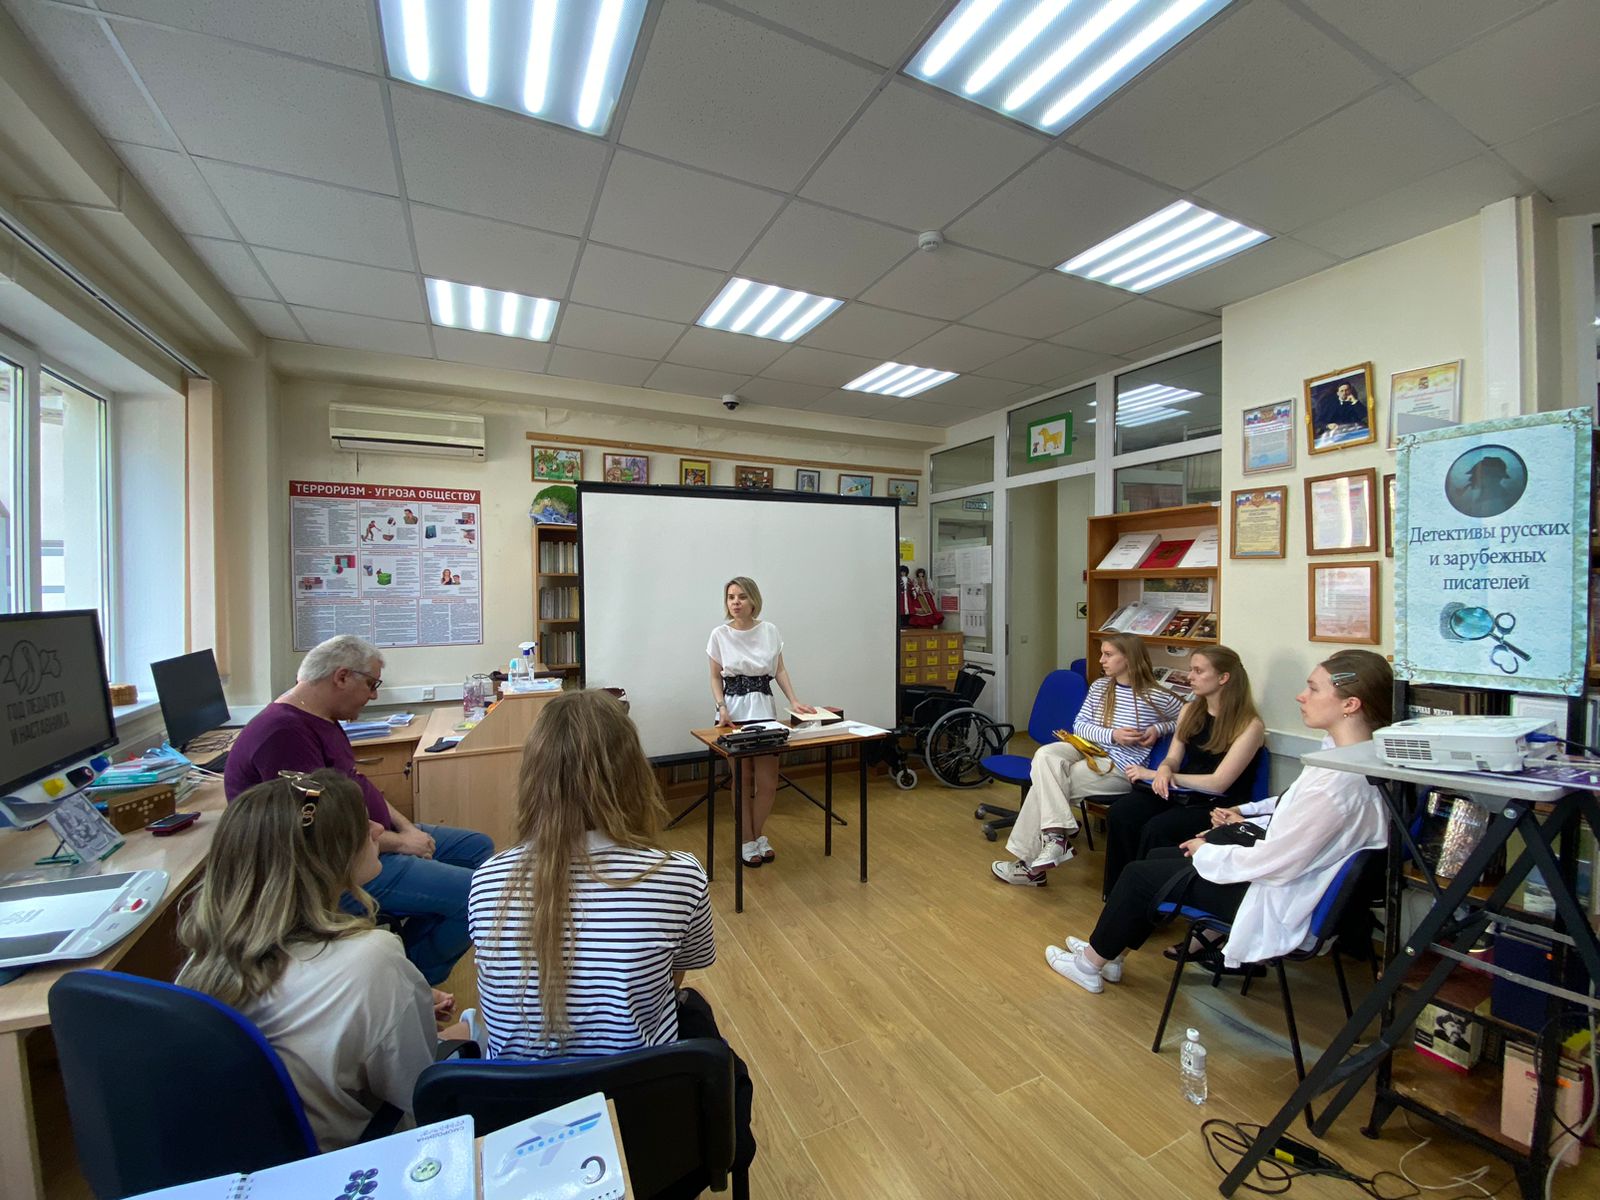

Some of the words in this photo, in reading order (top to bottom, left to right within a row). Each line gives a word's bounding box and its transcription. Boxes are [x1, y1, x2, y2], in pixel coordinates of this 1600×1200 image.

[295, 483, 366, 496] ТЕРРОРИЗМ
[375, 487, 417, 499] УГРОЗА
[418, 490, 477, 501] ОБЩЕСТВУ
[1409, 526, 1496, 546] Детективы
[1500, 522, 1571, 543] русских
[1429, 554, 1440, 566] и
[1443, 547, 1547, 570] зарубежных
[1443, 574, 1530, 590] писателей
[6, 700, 26, 722] ГОД
[26, 690, 67, 716] ПЕДАГОГА
[18, 711, 71, 744] НАСТАВНИКА
